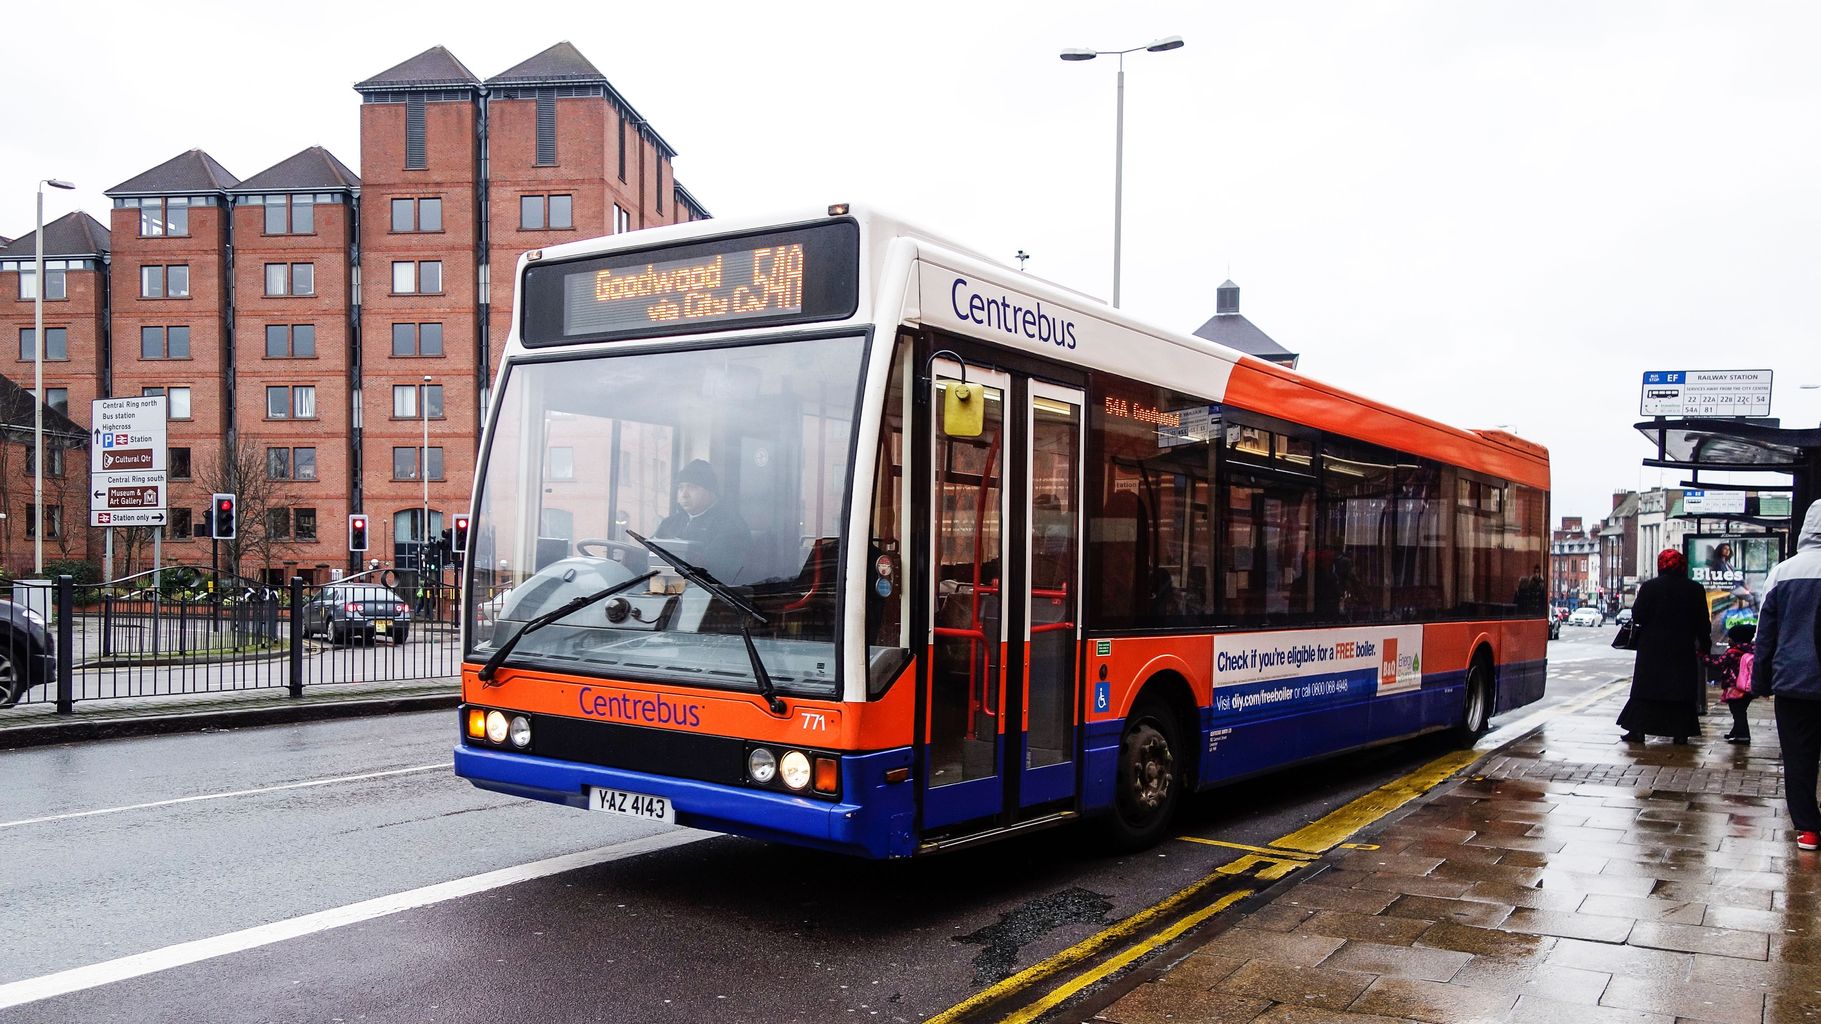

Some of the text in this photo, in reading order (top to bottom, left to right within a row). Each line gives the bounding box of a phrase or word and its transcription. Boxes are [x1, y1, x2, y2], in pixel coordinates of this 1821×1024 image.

[595, 244, 804, 309] Goodwood 54A
[648, 299, 680, 322] via
[684, 292, 728, 318] City
[951, 278, 1076, 350] Centrebus
[1667, 374, 1678, 382] EF
[126, 401, 139, 409] Ring
[1105, 396, 1180, 428] 54A Goodwood
[105, 435, 112, 445] P
[115, 454, 152, 463] Cultural Qtr
[121, 497, 142, 505] Gallery
[1692, 568, 1744, 581] Blues
[1218, 641, 1376, 672] Check if you're eligible for a FREE boiler.
[1398, 653, 1413, 670] Energy
[1383, 660, 1396, 677] B&Q
[1216, 695, 1230, 711] Visit
[1232, 687, 1293, 711] diy.com/freeboiler
[1294, 688, 1300, 698] or
[1302, 683, 1311, 697] call
[1312, 682, 1325, 696] 0800
[578, 686, 700, 728] Centrebus
[800, 712, 826, 732] 771
[598, 788, 665, 818] YAZ 4143
